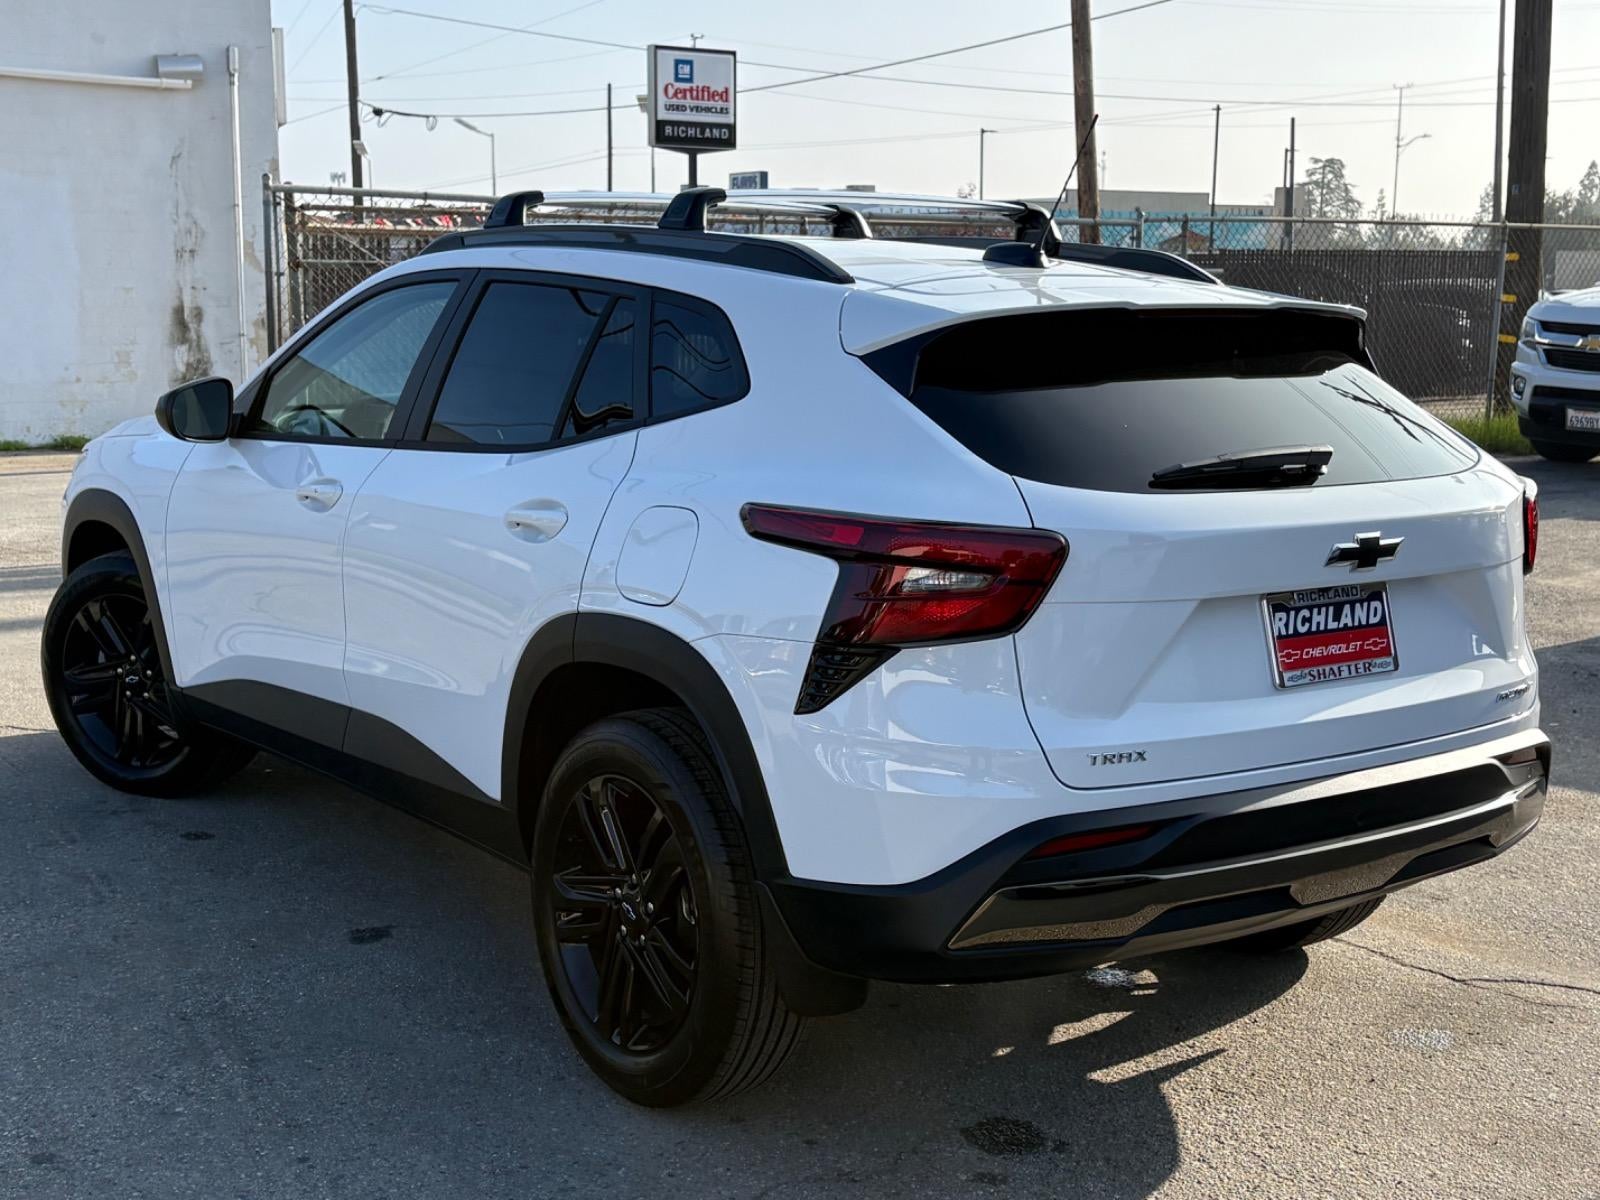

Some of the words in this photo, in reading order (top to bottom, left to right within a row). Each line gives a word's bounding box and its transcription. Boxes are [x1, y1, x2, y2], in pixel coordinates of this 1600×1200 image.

[664, 82, 730, 103] Certified
[664, 103, 687, 113] USED
[688, 104, 730, 115] VEHICLES
[664, 125, 729, 139] RICHLAND
[1296, 585, 1359, 603] RICHLAND
[1274, 600, 1383, 636] RICHLAND
[1302, 641, 1362, 659] CHEVROLET
[1308, 660, 1373, 682] SHAFTER
[1087, 750, 1147, 766] TRAX
